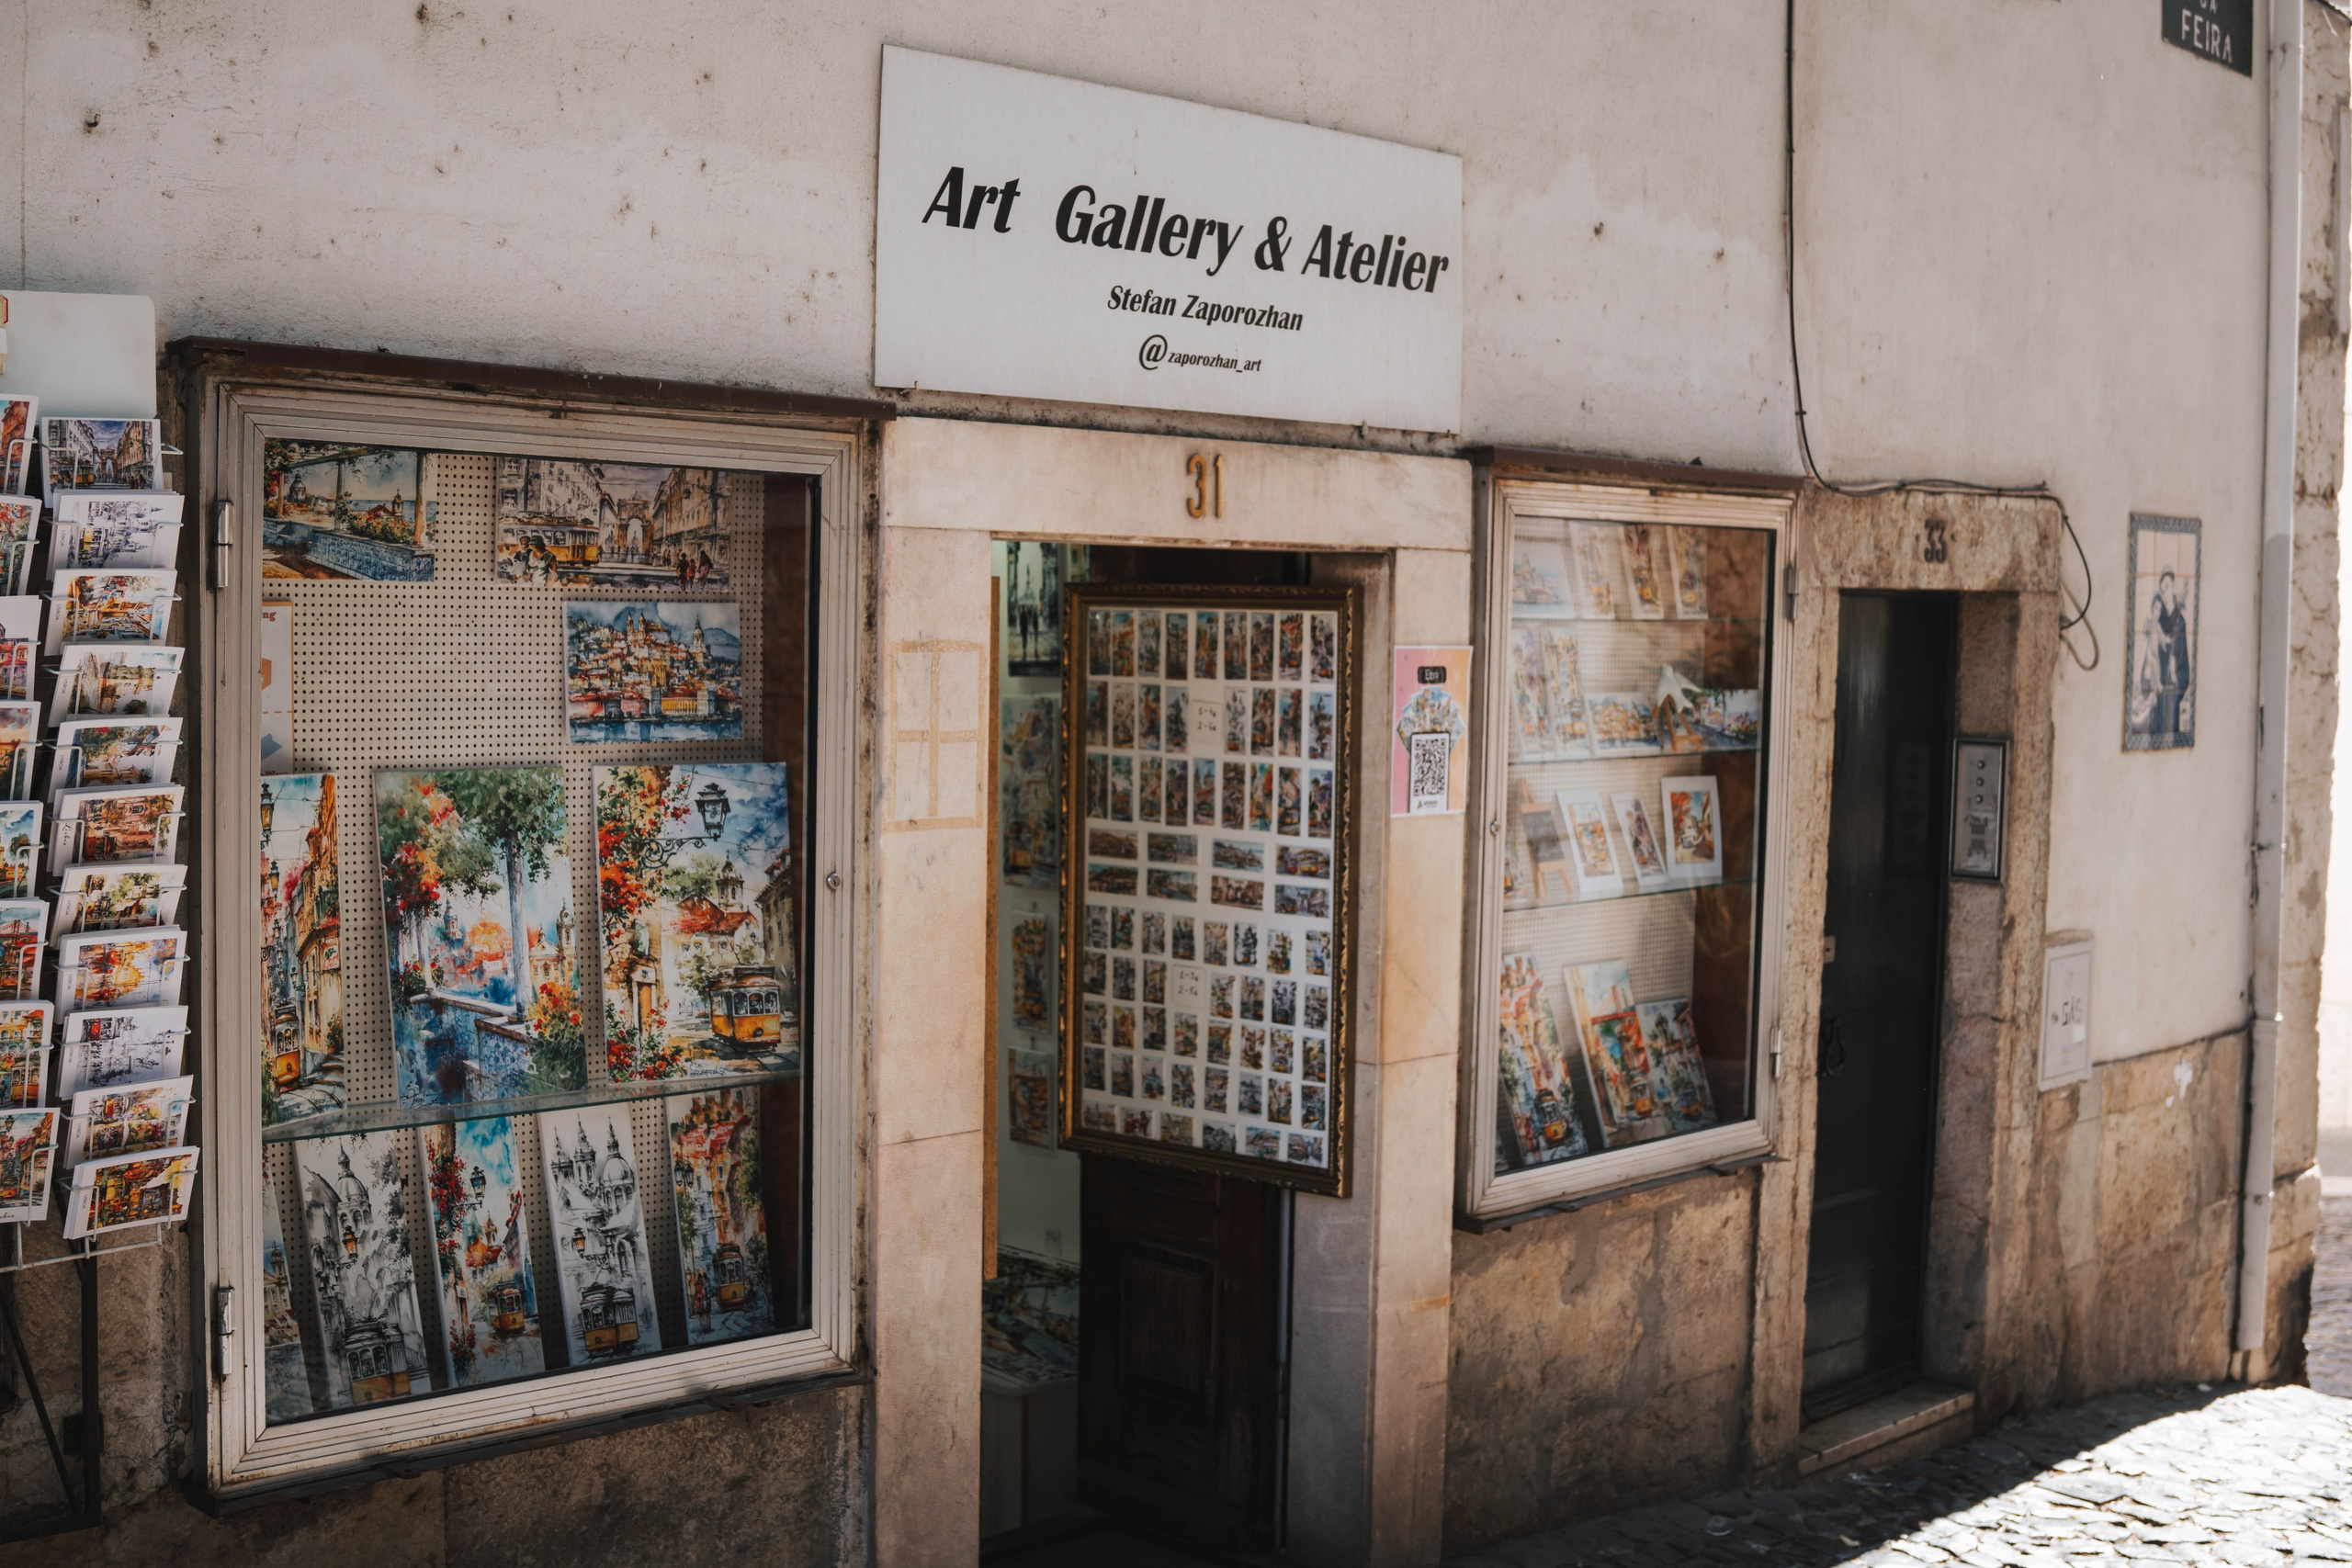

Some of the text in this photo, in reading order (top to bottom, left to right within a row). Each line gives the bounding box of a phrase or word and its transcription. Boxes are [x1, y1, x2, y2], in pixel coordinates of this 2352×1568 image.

[2181, 7, 2233, 64] FEIRA
[922, 165, 1449, 293] Art Gallery & Atelier
[1106, 285, 1305, 332] Stefan Zaporozhan
[1138, 333, 1262, 375] @zaporozhan_art
[1185, 451, 1224, 519] 31
